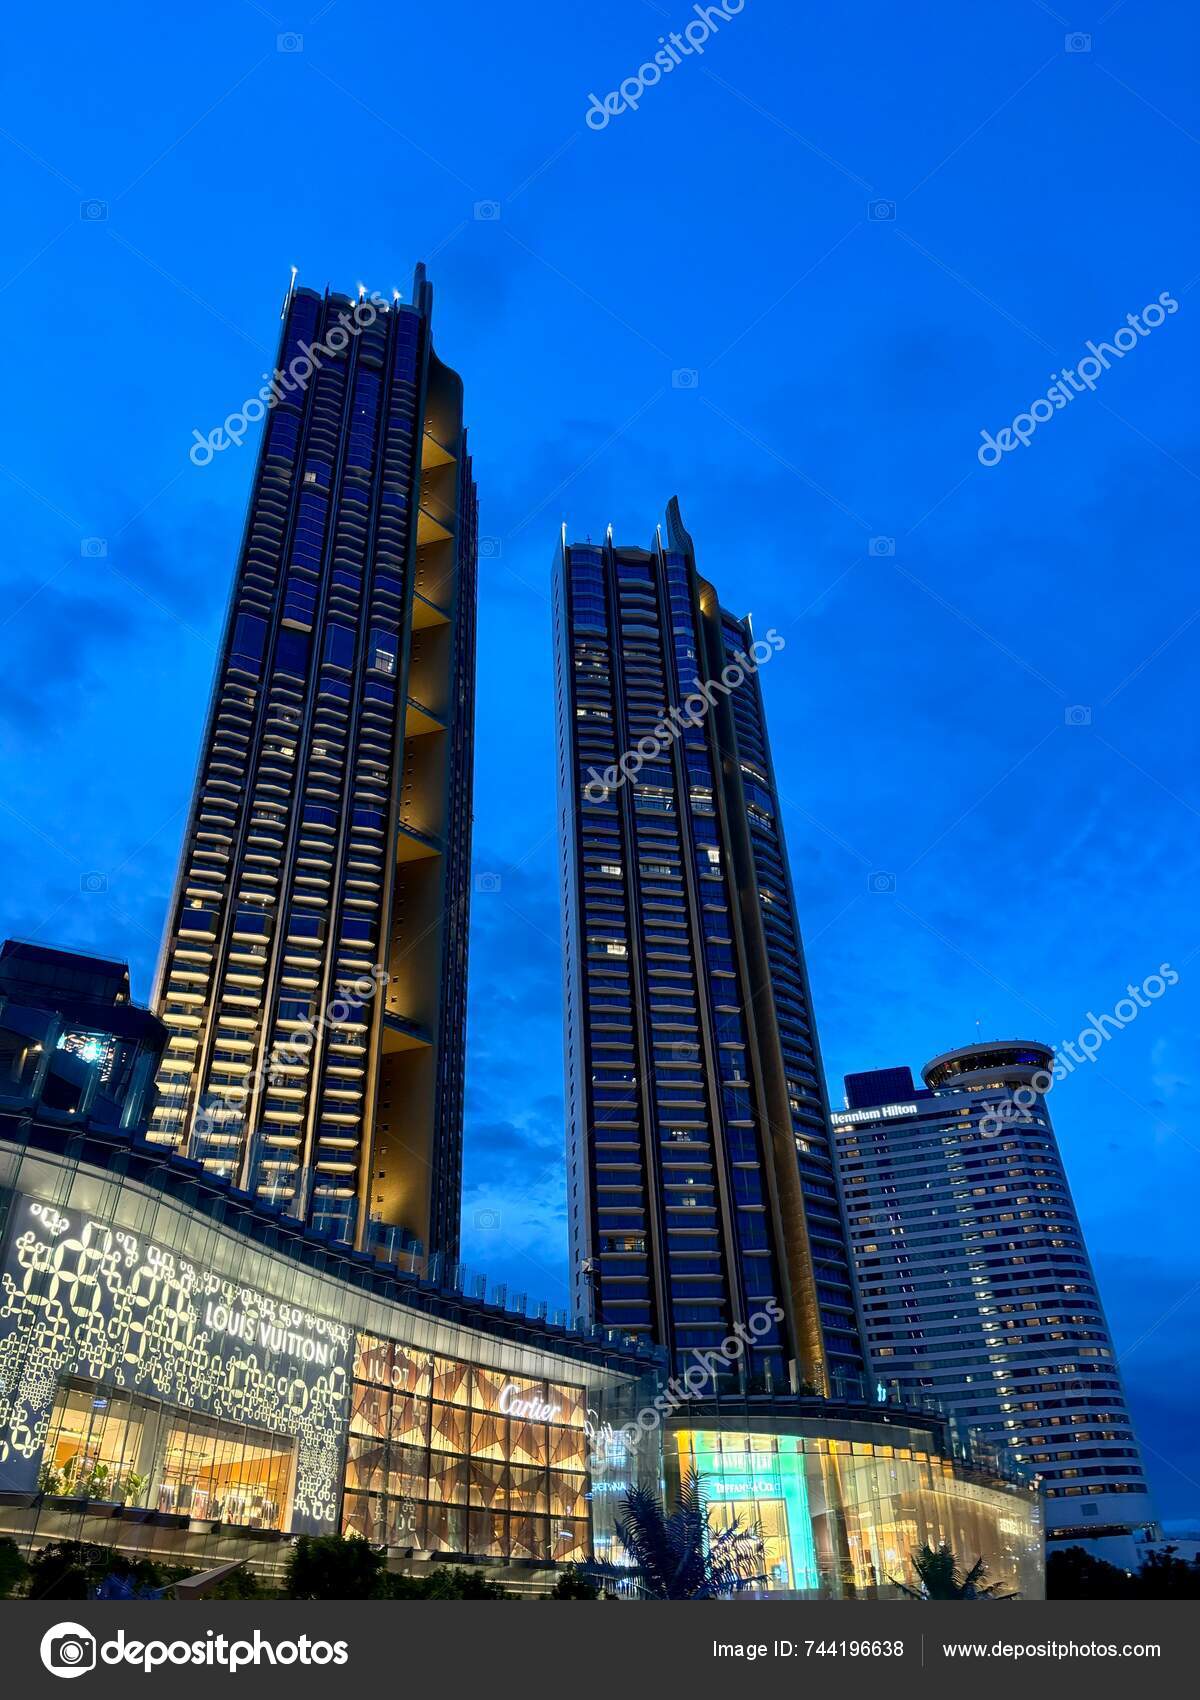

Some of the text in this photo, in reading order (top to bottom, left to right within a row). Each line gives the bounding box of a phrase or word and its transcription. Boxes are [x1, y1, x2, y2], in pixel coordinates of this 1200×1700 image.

[830, 1104, 917, 1125] llennium Hilton
[205, 1302, 329, 1367] LOUIS VUITTON
[499, 1382, 561, 1421] Cartier
